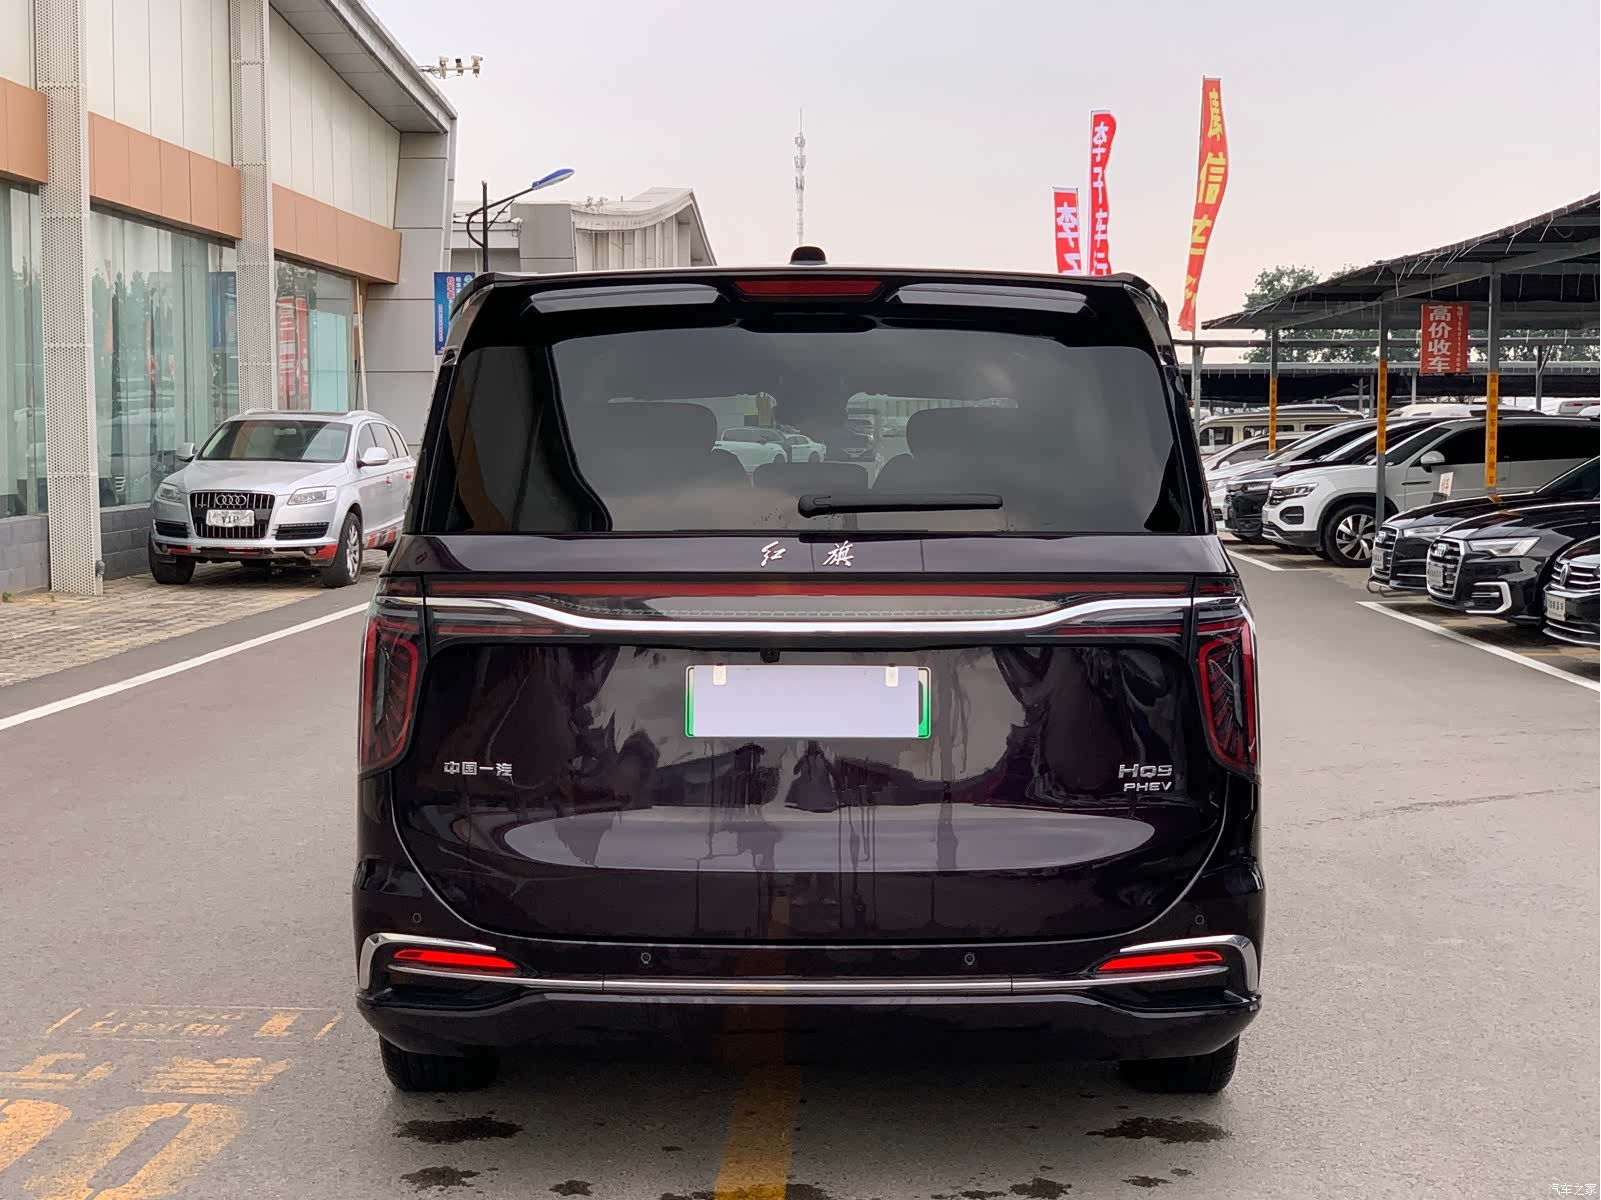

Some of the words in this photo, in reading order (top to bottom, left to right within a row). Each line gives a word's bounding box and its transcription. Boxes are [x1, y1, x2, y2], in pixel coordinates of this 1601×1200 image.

[1427, 304, 1453, 373] 高价收车
[760, 540, 854, 567] 红旗
[443, 760, 513, 777] 中国一汽
[1123, 781, 1172, 792] PHEV
